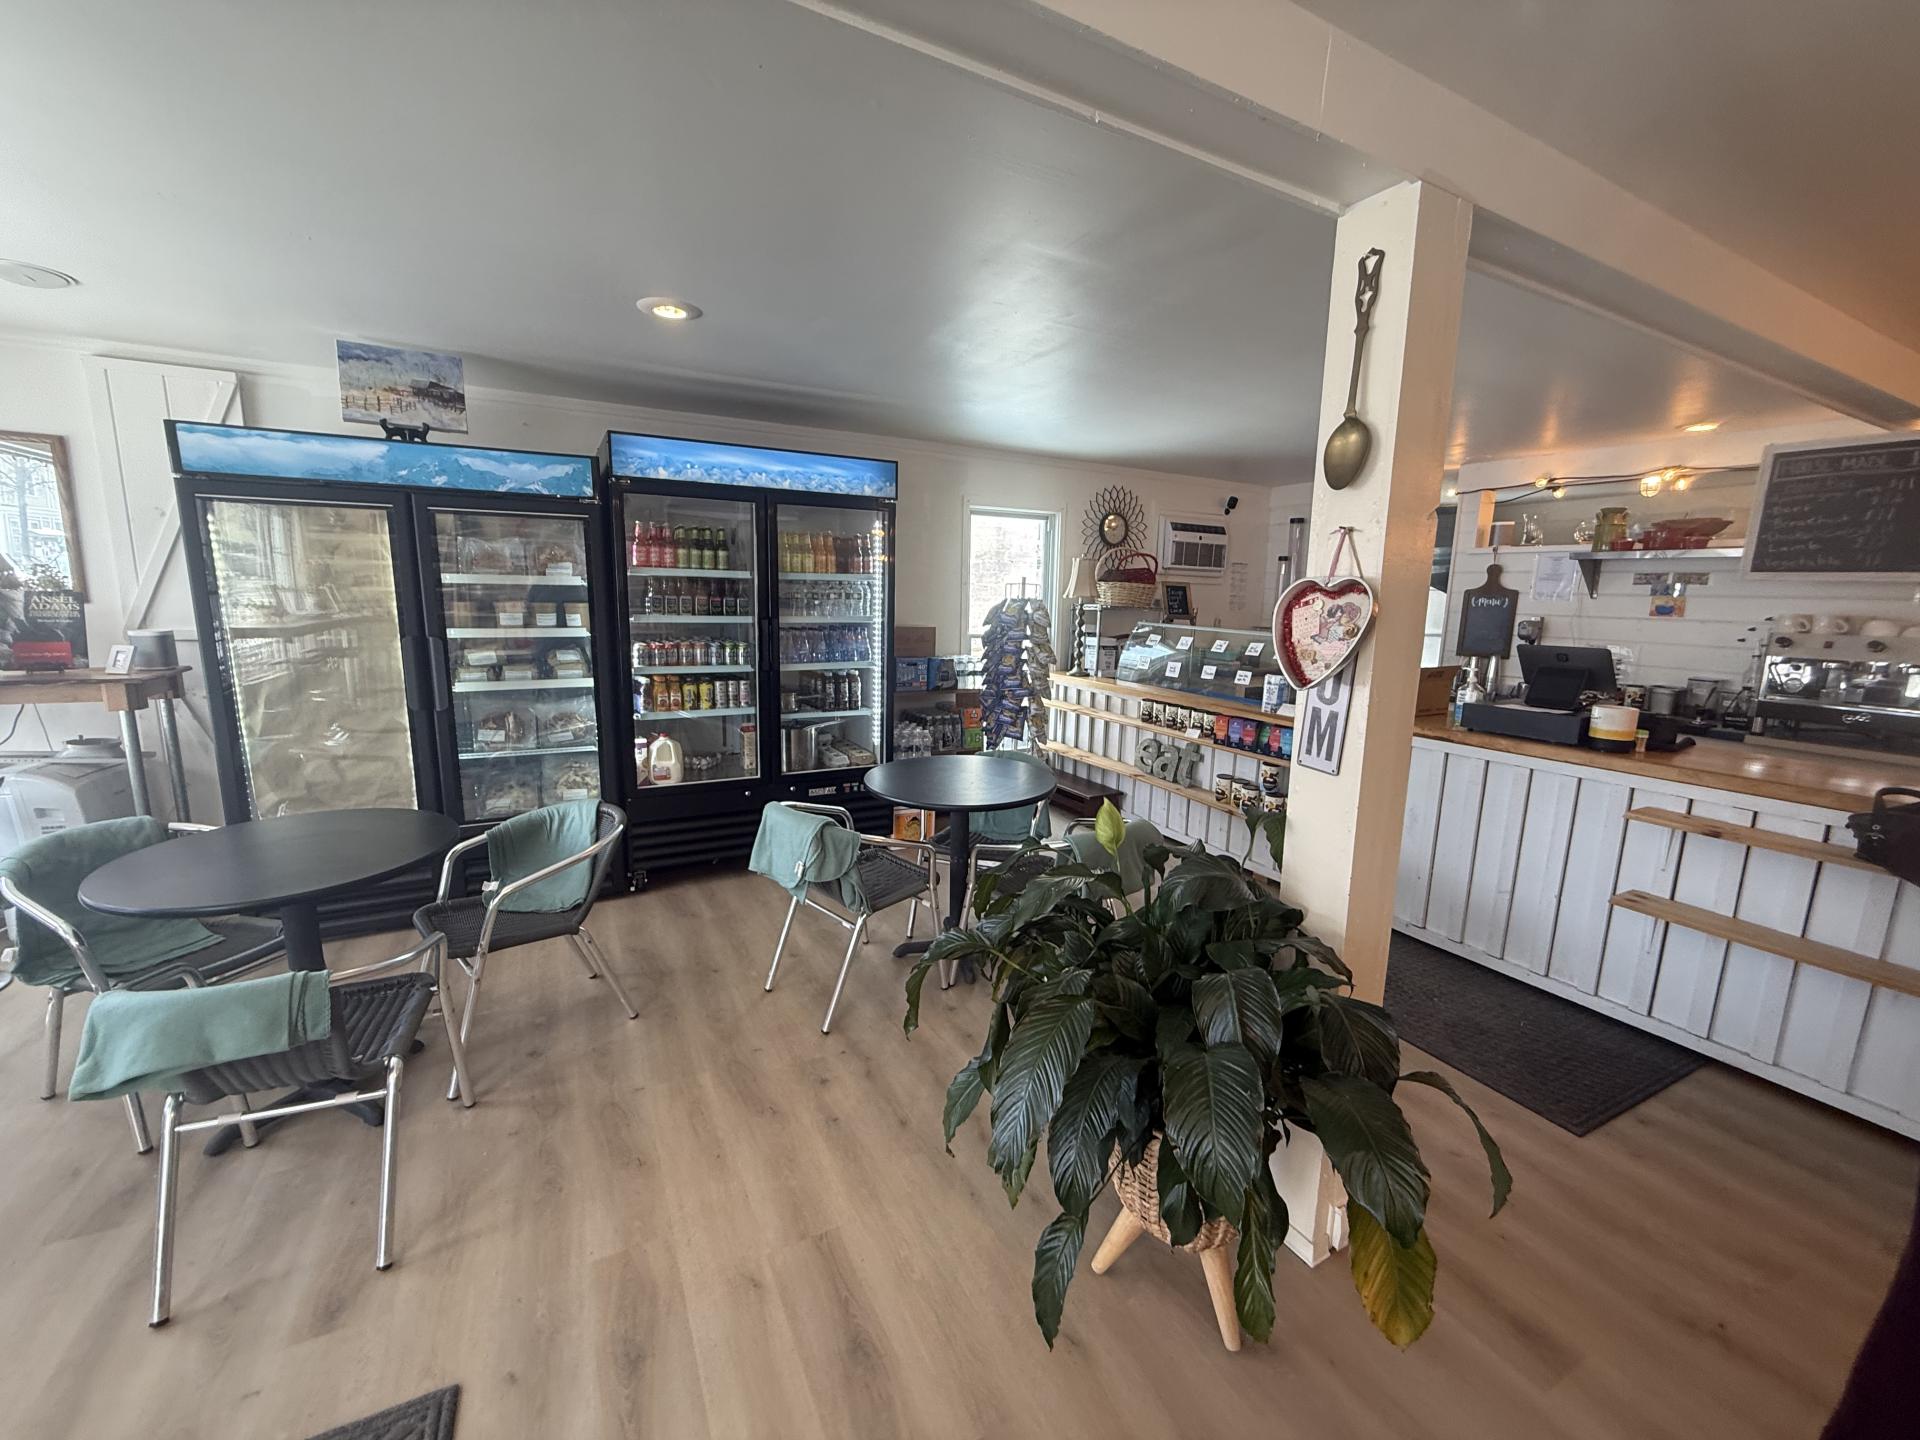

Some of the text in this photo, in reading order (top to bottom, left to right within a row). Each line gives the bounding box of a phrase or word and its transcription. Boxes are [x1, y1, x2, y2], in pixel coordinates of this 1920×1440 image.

[31, 594, 77, 604] ANSEL
[28, 602, 80, 611] ADAMS
[1134, 737, 1205, 788] eat
